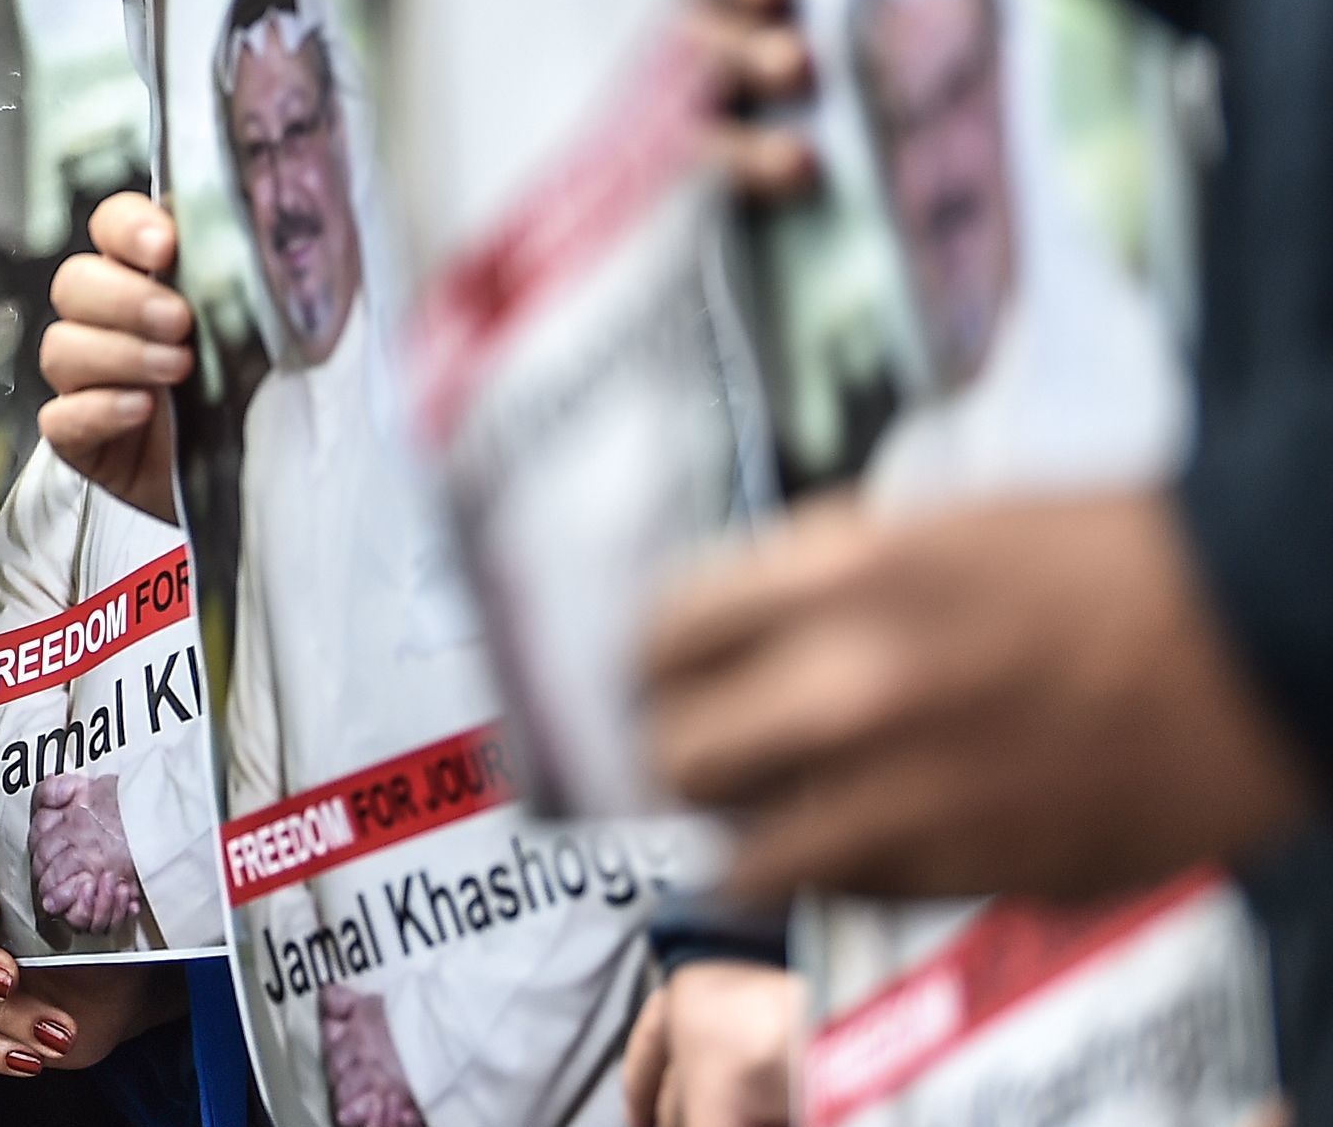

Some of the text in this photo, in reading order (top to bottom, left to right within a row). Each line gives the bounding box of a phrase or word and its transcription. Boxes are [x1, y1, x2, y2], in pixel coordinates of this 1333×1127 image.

[226, 796, 354, 888] FREEDOM
[350, 776, 418, 836] FOR
[264, 893, 383, 1004] Jamal
